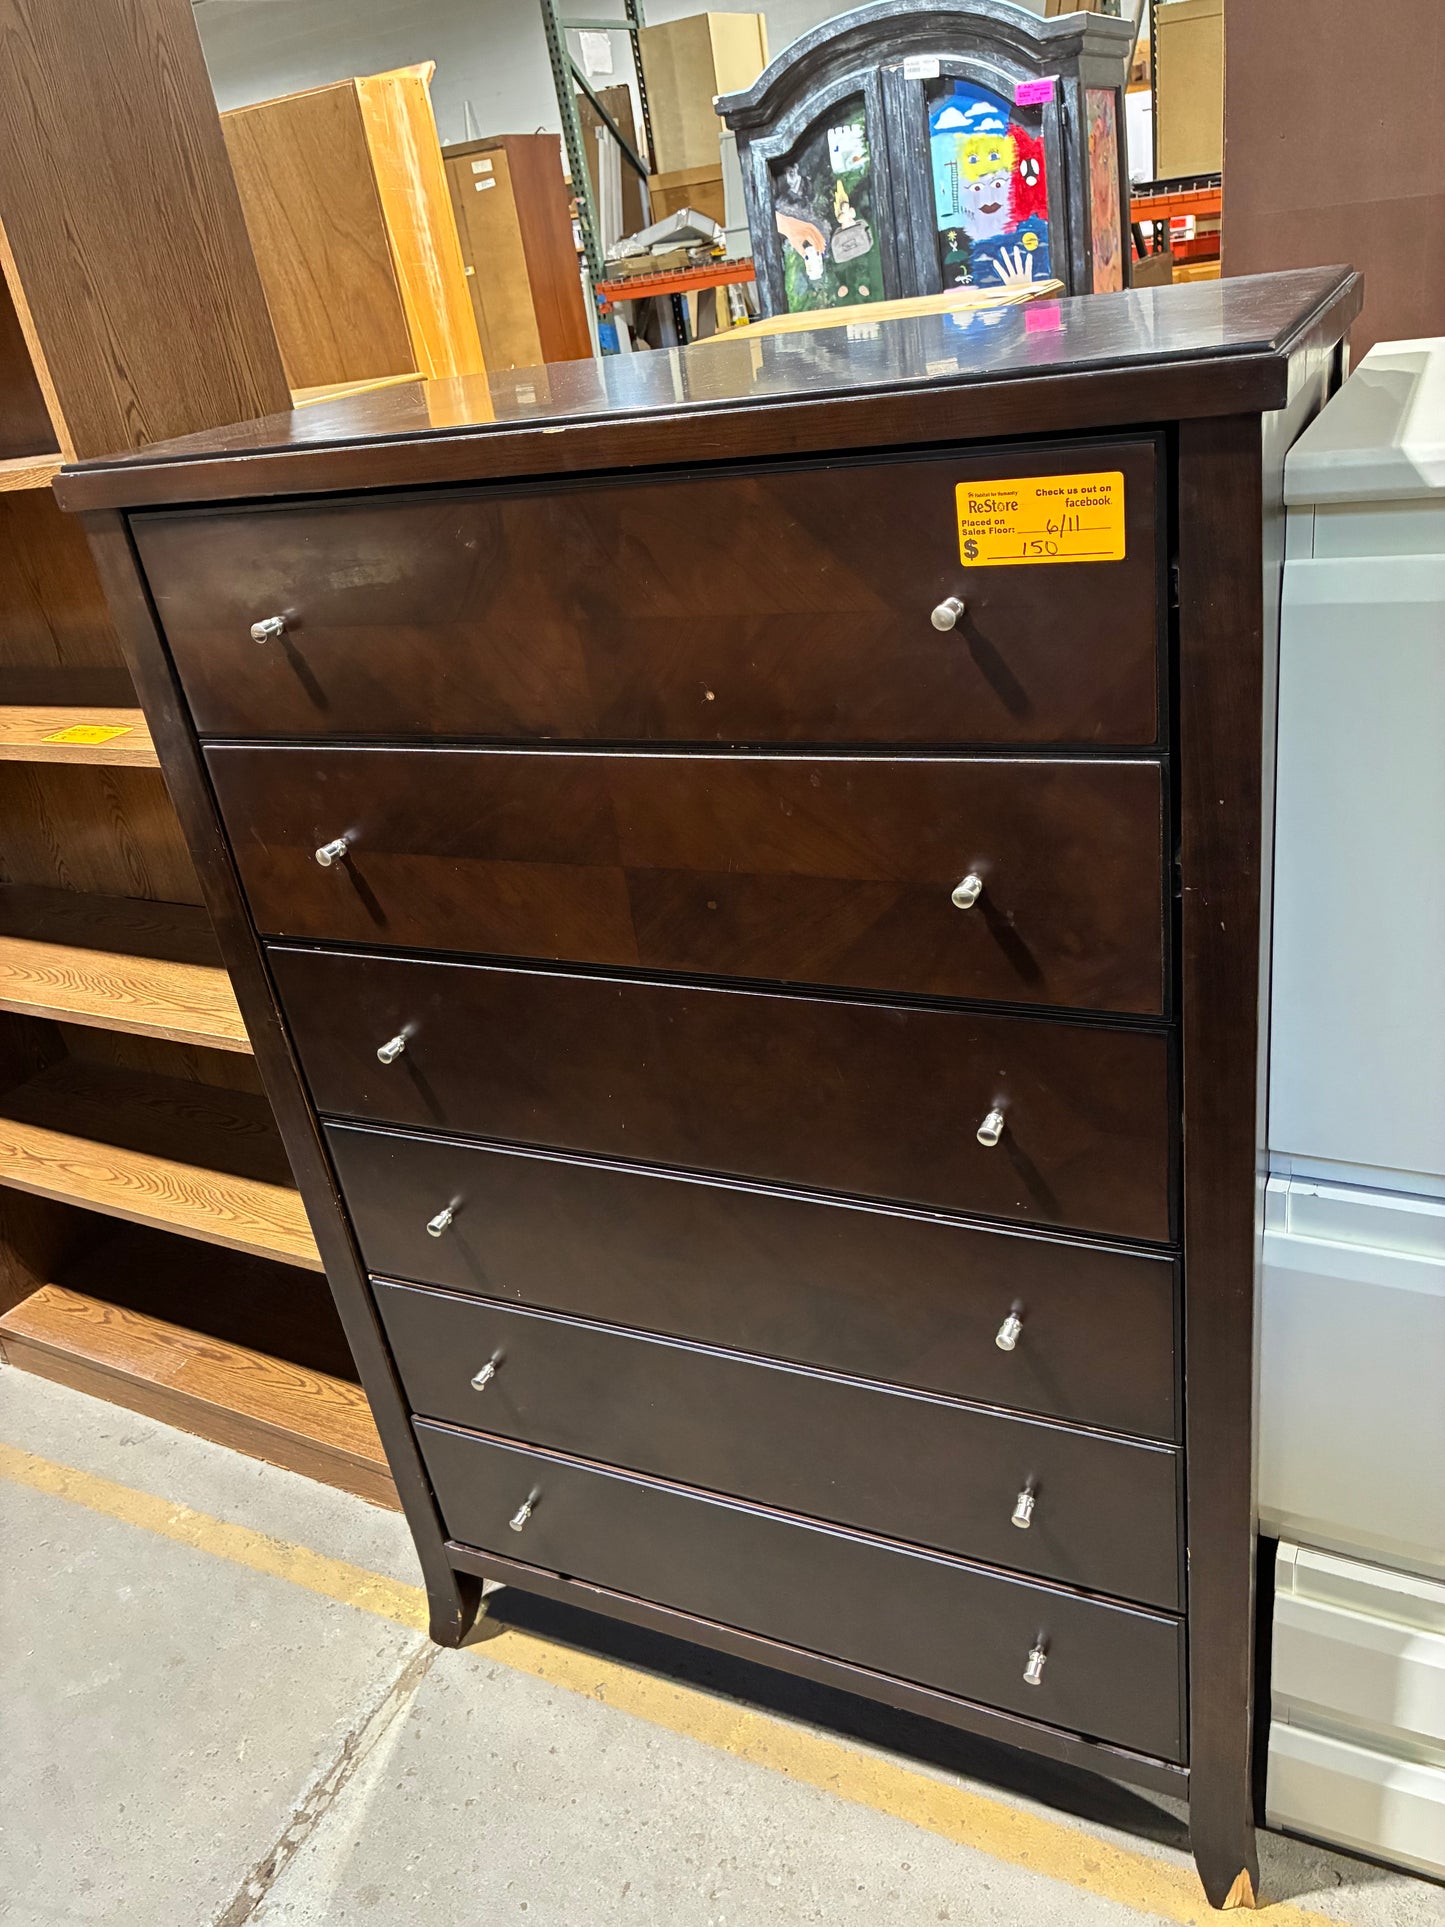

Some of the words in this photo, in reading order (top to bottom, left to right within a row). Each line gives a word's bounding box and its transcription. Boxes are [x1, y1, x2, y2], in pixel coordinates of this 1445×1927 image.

[1035, 488, 1065, 497] Check
[1081, 485, 1097, 494] out
[968, 499, 1019, 514] ReStore
[961, 518, 991, 527] Placed
[962, 528, 986, 536] Sales
[988, 527, 1015, 535] Floor:
[1046, 514, 1080, 539] 6/11
[963, 538, 979, 561] $
[1022, 540, 1058, 556] 150
